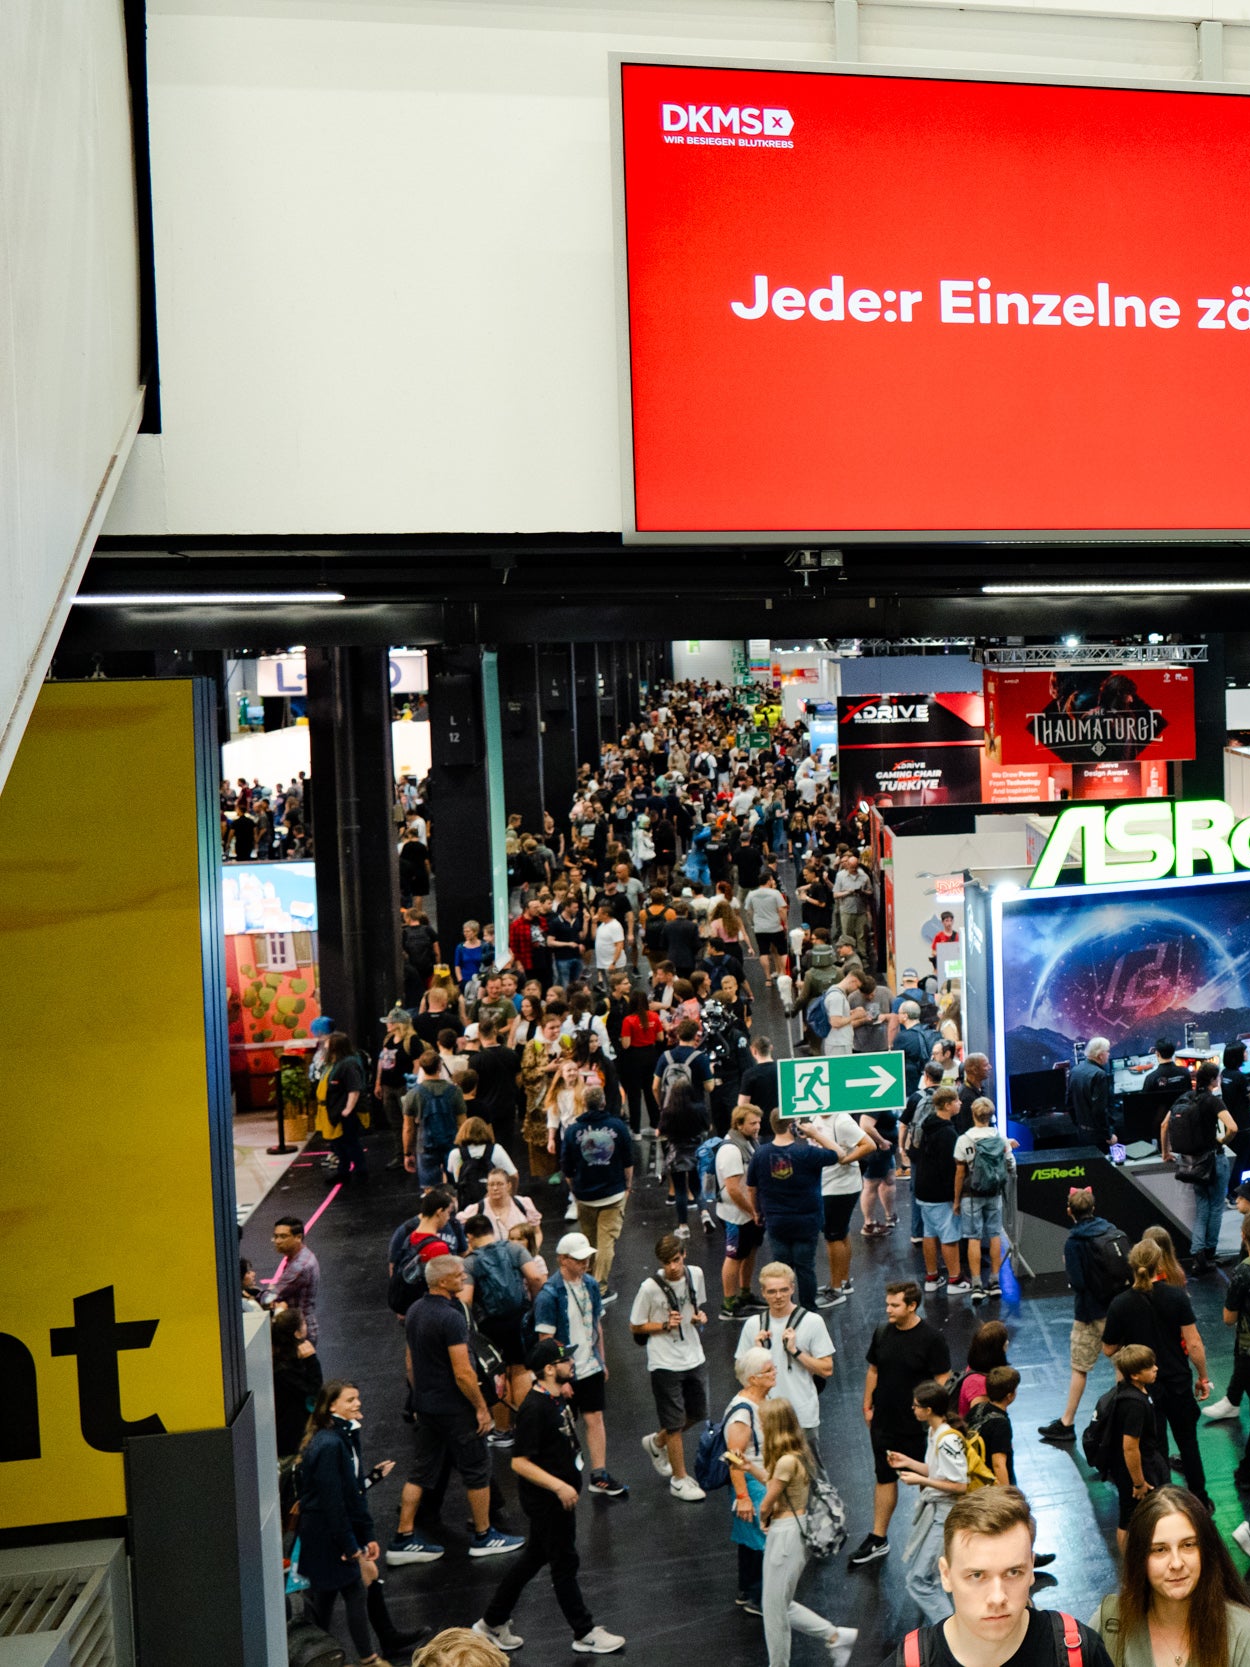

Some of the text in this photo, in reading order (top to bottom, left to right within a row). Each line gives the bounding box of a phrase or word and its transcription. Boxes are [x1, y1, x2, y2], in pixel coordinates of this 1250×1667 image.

[662, 104, 763, 135] DKMS
[664, 136, 794, 149] WIR BESIEGEN BLUTKREBS
[730, 275, 923, 323] Jede:r
[939, 277, 1181, 329] Einzelne
[450, 716, 456, 725] L
[1026, 709, 1163, 746] THAUMATURGE
[449, 733, 460, 743] 12
[875, 771, 912, 779] GAMING
[913, 769, 942, 778] CHAIR
[1031, 1166, 1086, 1181] ASRock
